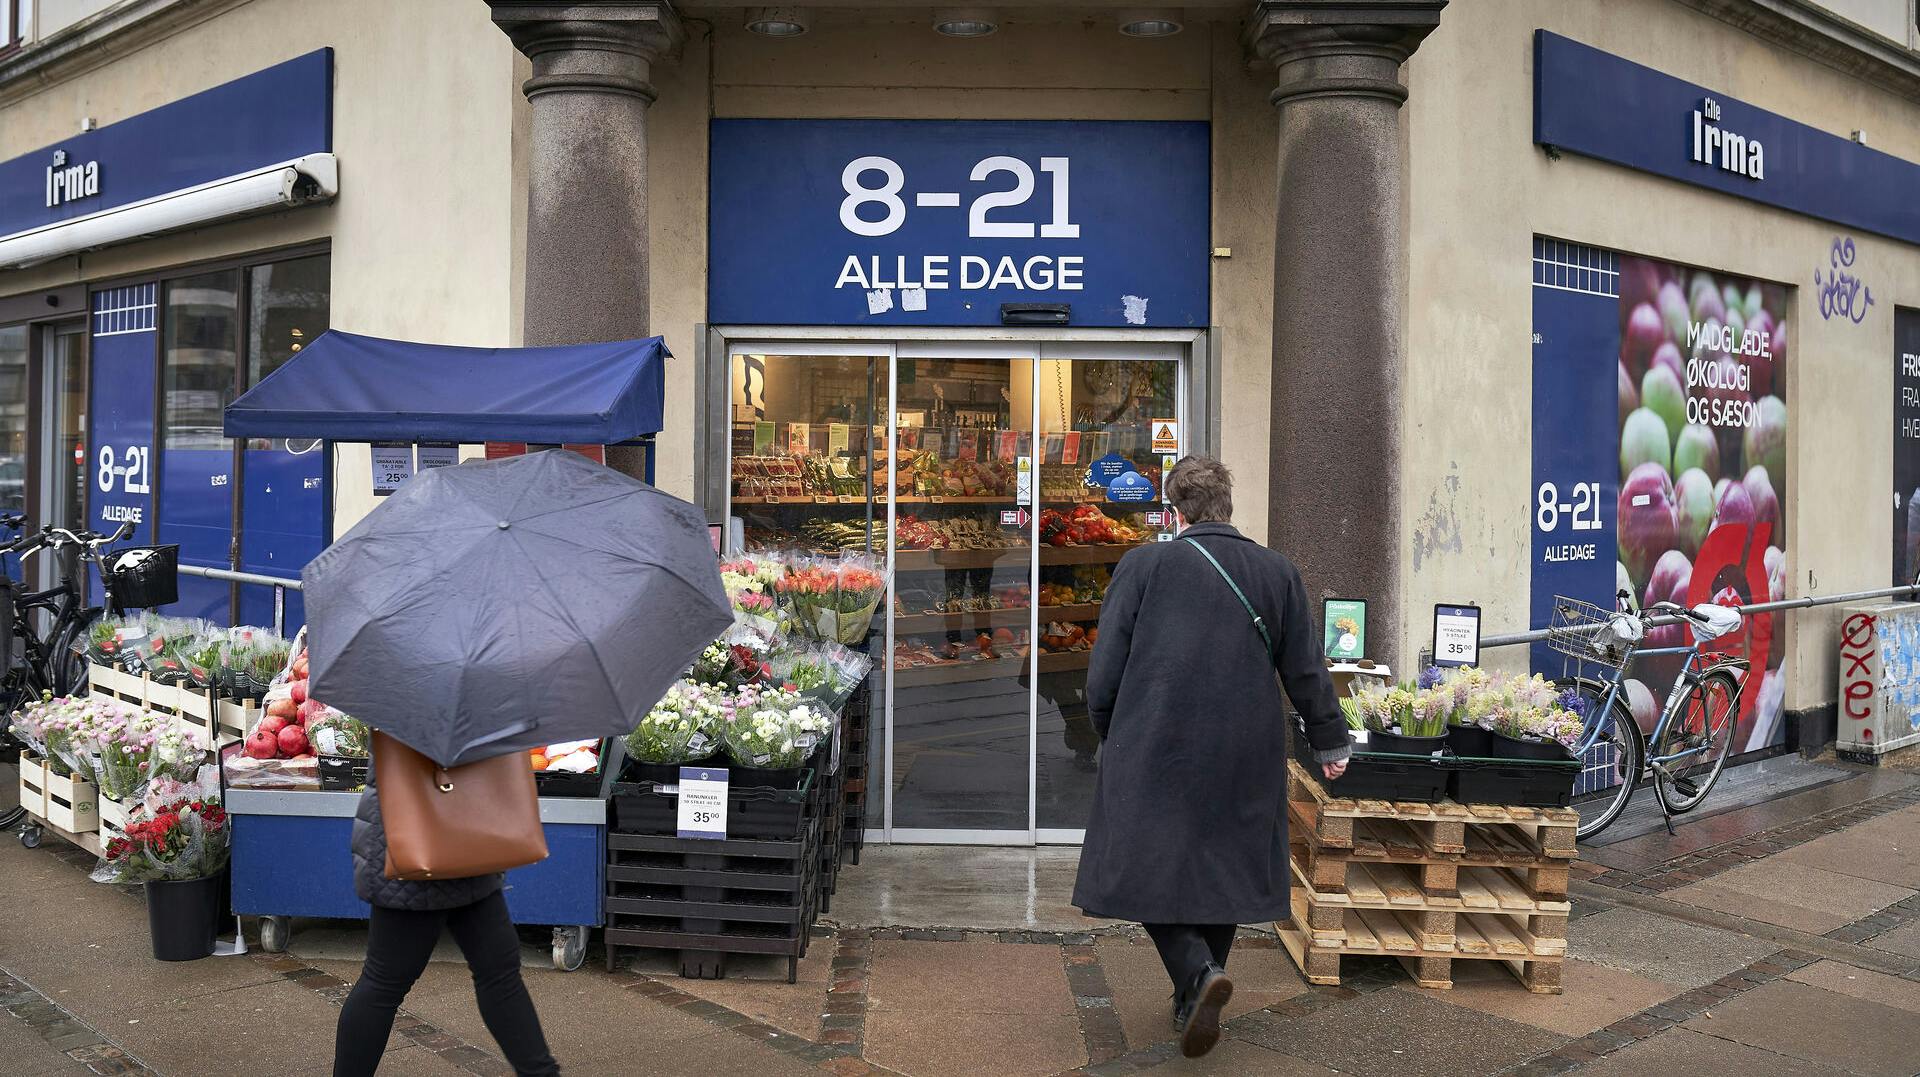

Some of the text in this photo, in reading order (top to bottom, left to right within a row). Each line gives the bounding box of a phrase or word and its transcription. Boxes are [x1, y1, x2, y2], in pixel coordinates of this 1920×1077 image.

[1694, 109, 1764, 180] Irma
[46, 160, 98, 207] Irma
[834, 255, 1084, 291] ALLE DAGE
[1687, 320, 1773, 361] MADGLÆDE,
[1686, 357, 1750, 391] ØKOLOGI
[1686, 396, 1762, 428] OG SÆSON
[98, 445, 150, 494] 8-21
[101, 505, 142, 524] ALLE DAGE
[1537, 481, 1603, 532] 8-21
[1543, 543, 1596, 562] ALLE DAGE
